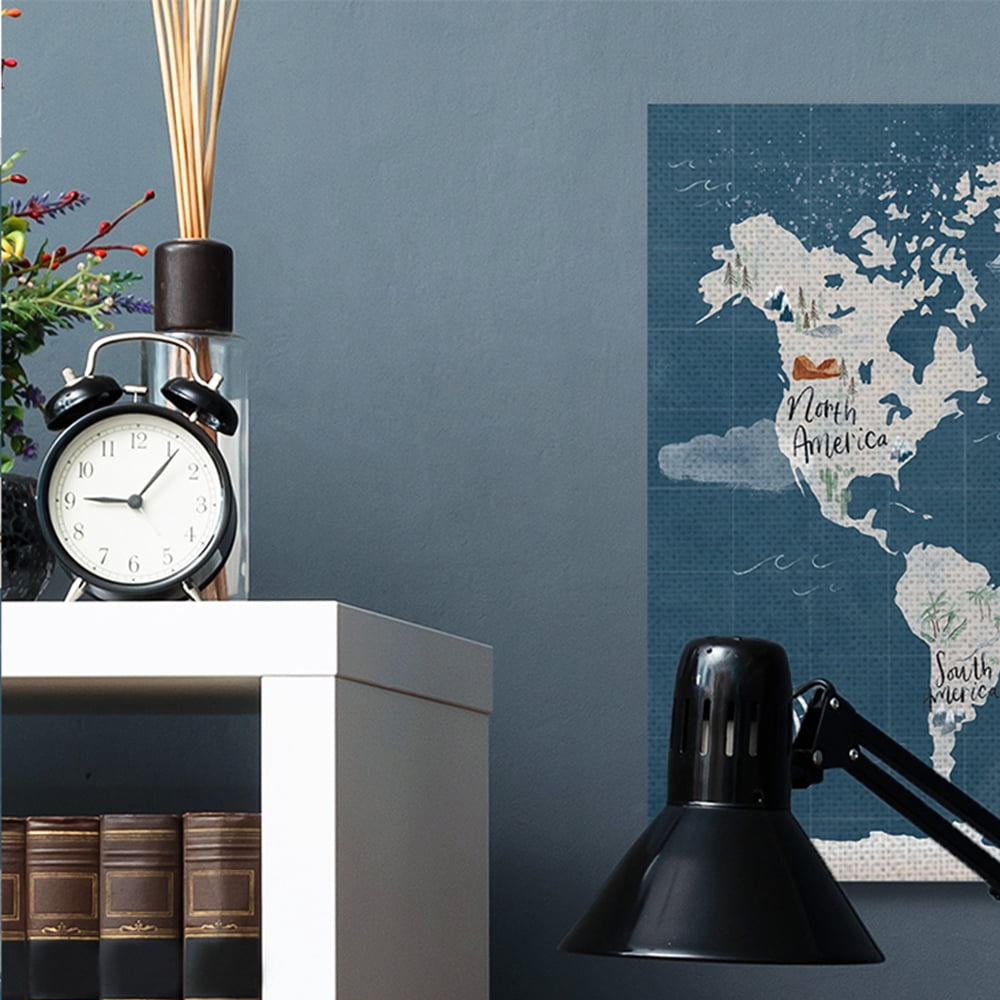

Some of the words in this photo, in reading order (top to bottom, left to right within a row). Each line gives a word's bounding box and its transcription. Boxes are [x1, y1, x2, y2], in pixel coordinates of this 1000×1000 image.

[787, 386, 856, 425] North
[102, 441, 114, 457] 11
[130, 432, 148, 449] 12
[793, 425, 888, 464] America
[79, 461, 94, 478] 10
[188, 463, 199, 480] 2
[64, 492, 76, 510] 9
[196, 496, 207, 513] 3
[73, 523, 85, 540] 8
[184, 526, 196, 542] 4
[99, 547, 109, 565] 7
[128, 555, 140, 573] 6
[162, 548, 173, 566] 5
[935, 650, 992, 688] South
